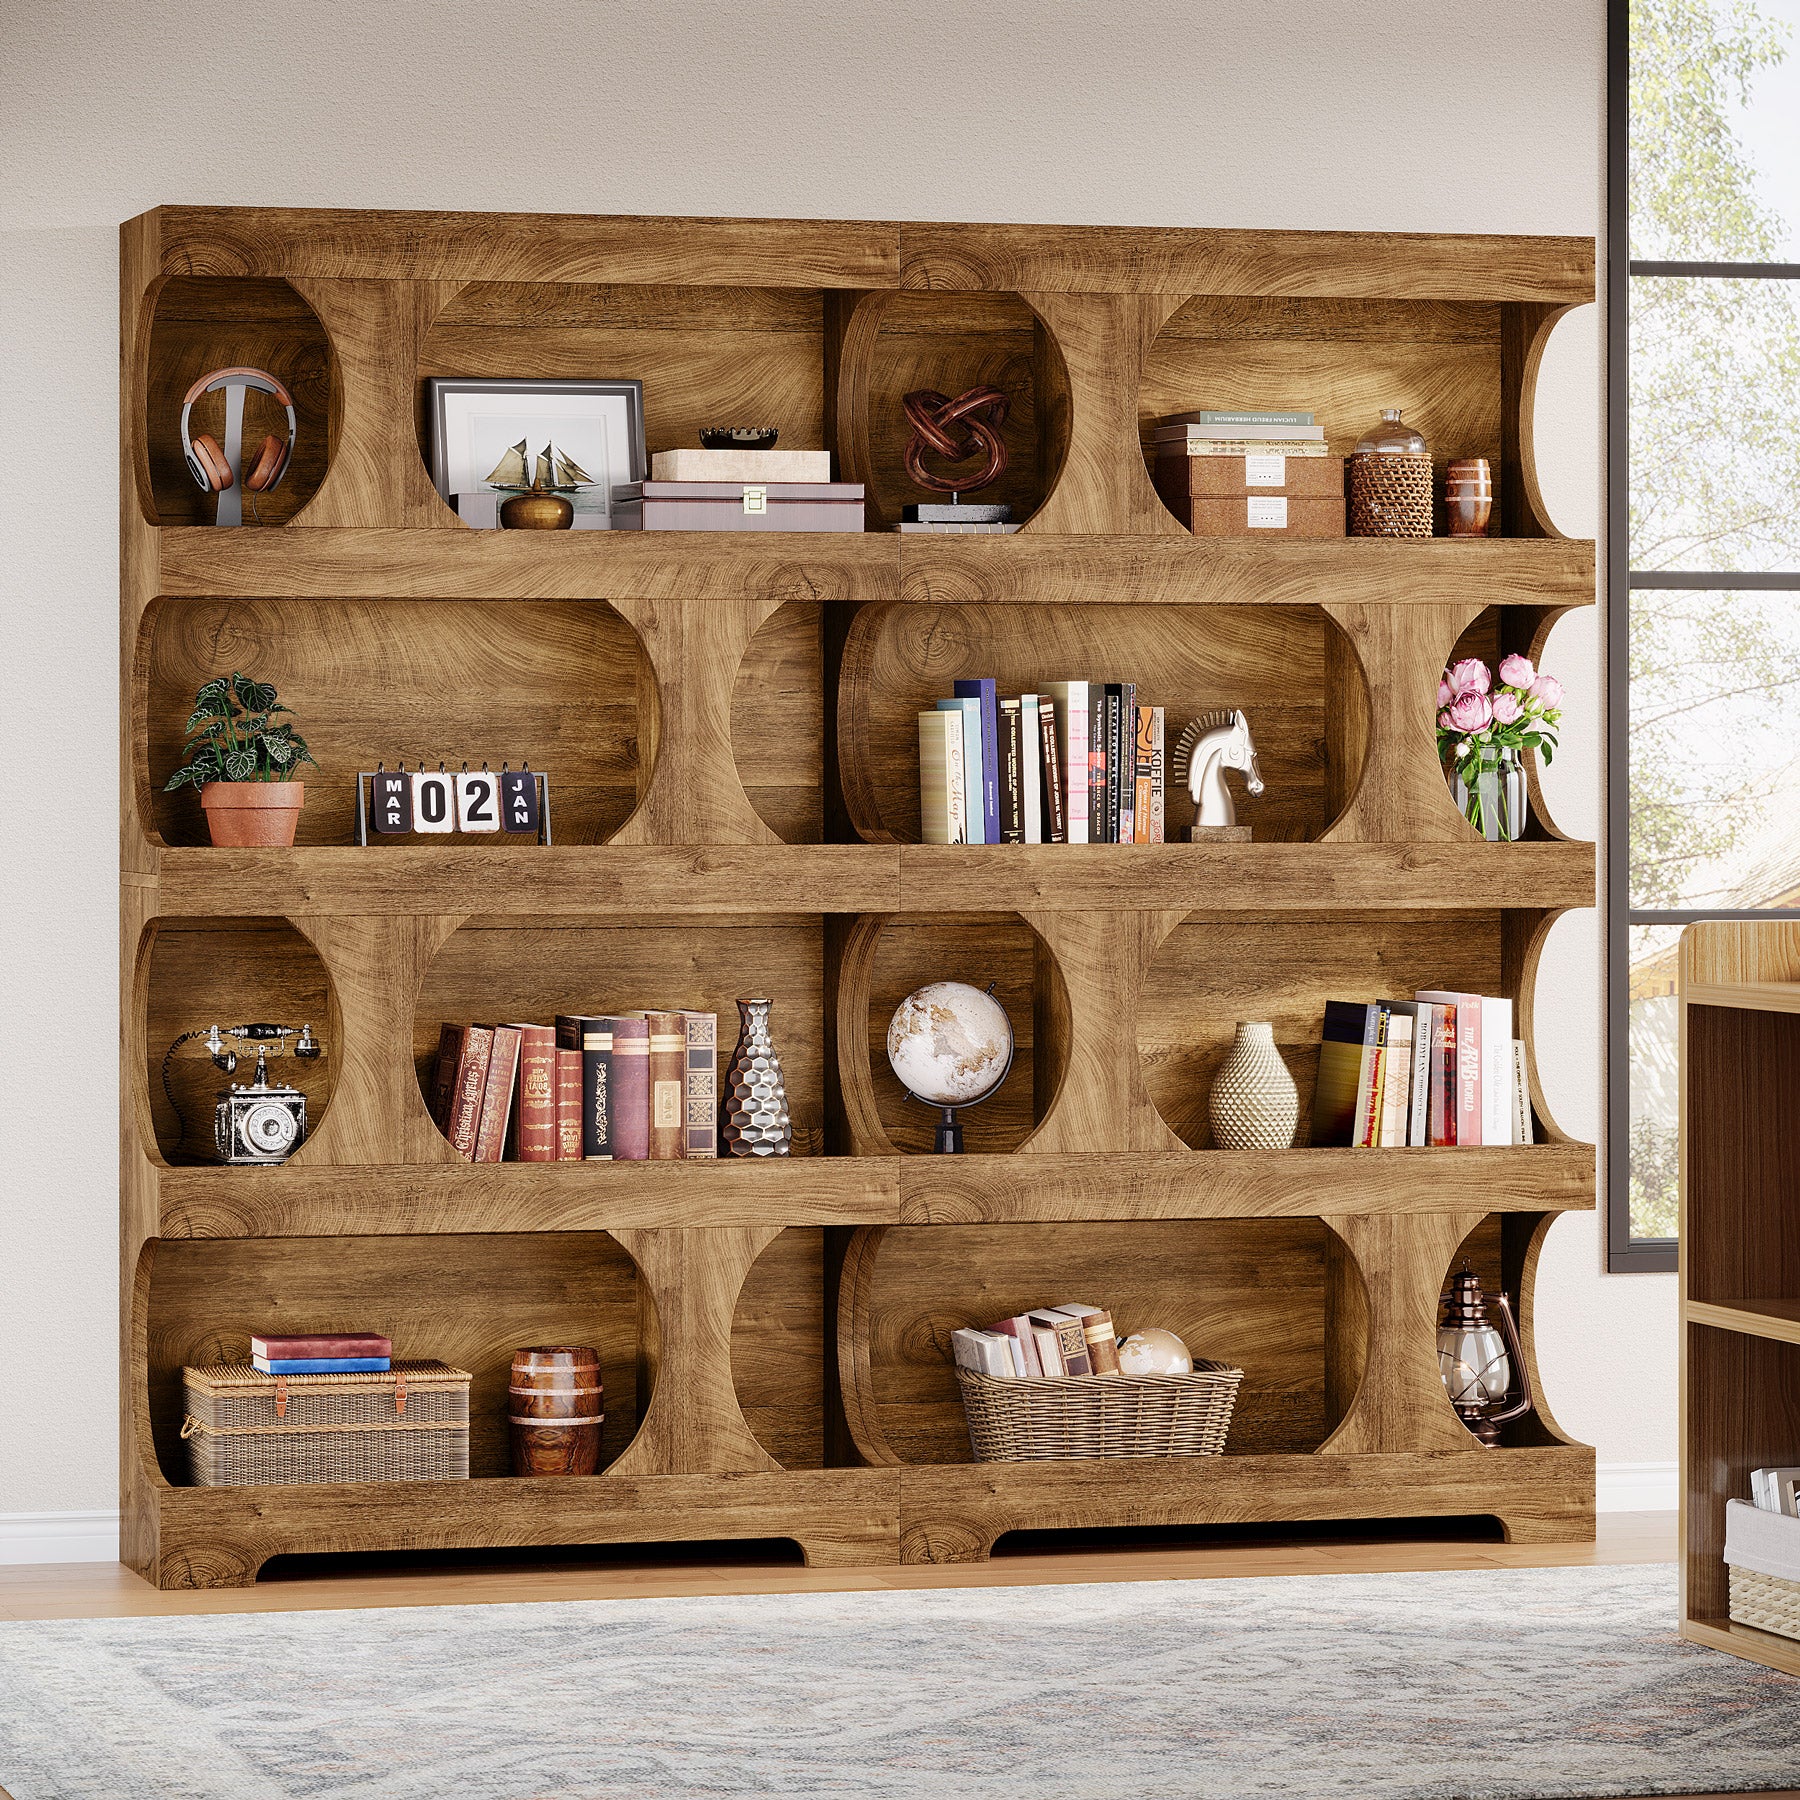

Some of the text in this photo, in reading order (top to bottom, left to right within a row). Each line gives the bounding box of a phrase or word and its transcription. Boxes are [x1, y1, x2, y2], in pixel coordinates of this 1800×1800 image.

[1112, 767, 1116, 778] WE
[1152, 750, 1162, 797] KOFFIE
[386, 780, 402, 824] MAR
[512, 780, 528, 824] JAN
[949, 780, 962, 820] Map
[1112, 817, 1116, 827] BY
[1368, 1011, 1377, 1044] Complete
[1461, 1027, 1478, 1111] THE ARAB WORLD
[455, 1102, 476, 1150] Christian
